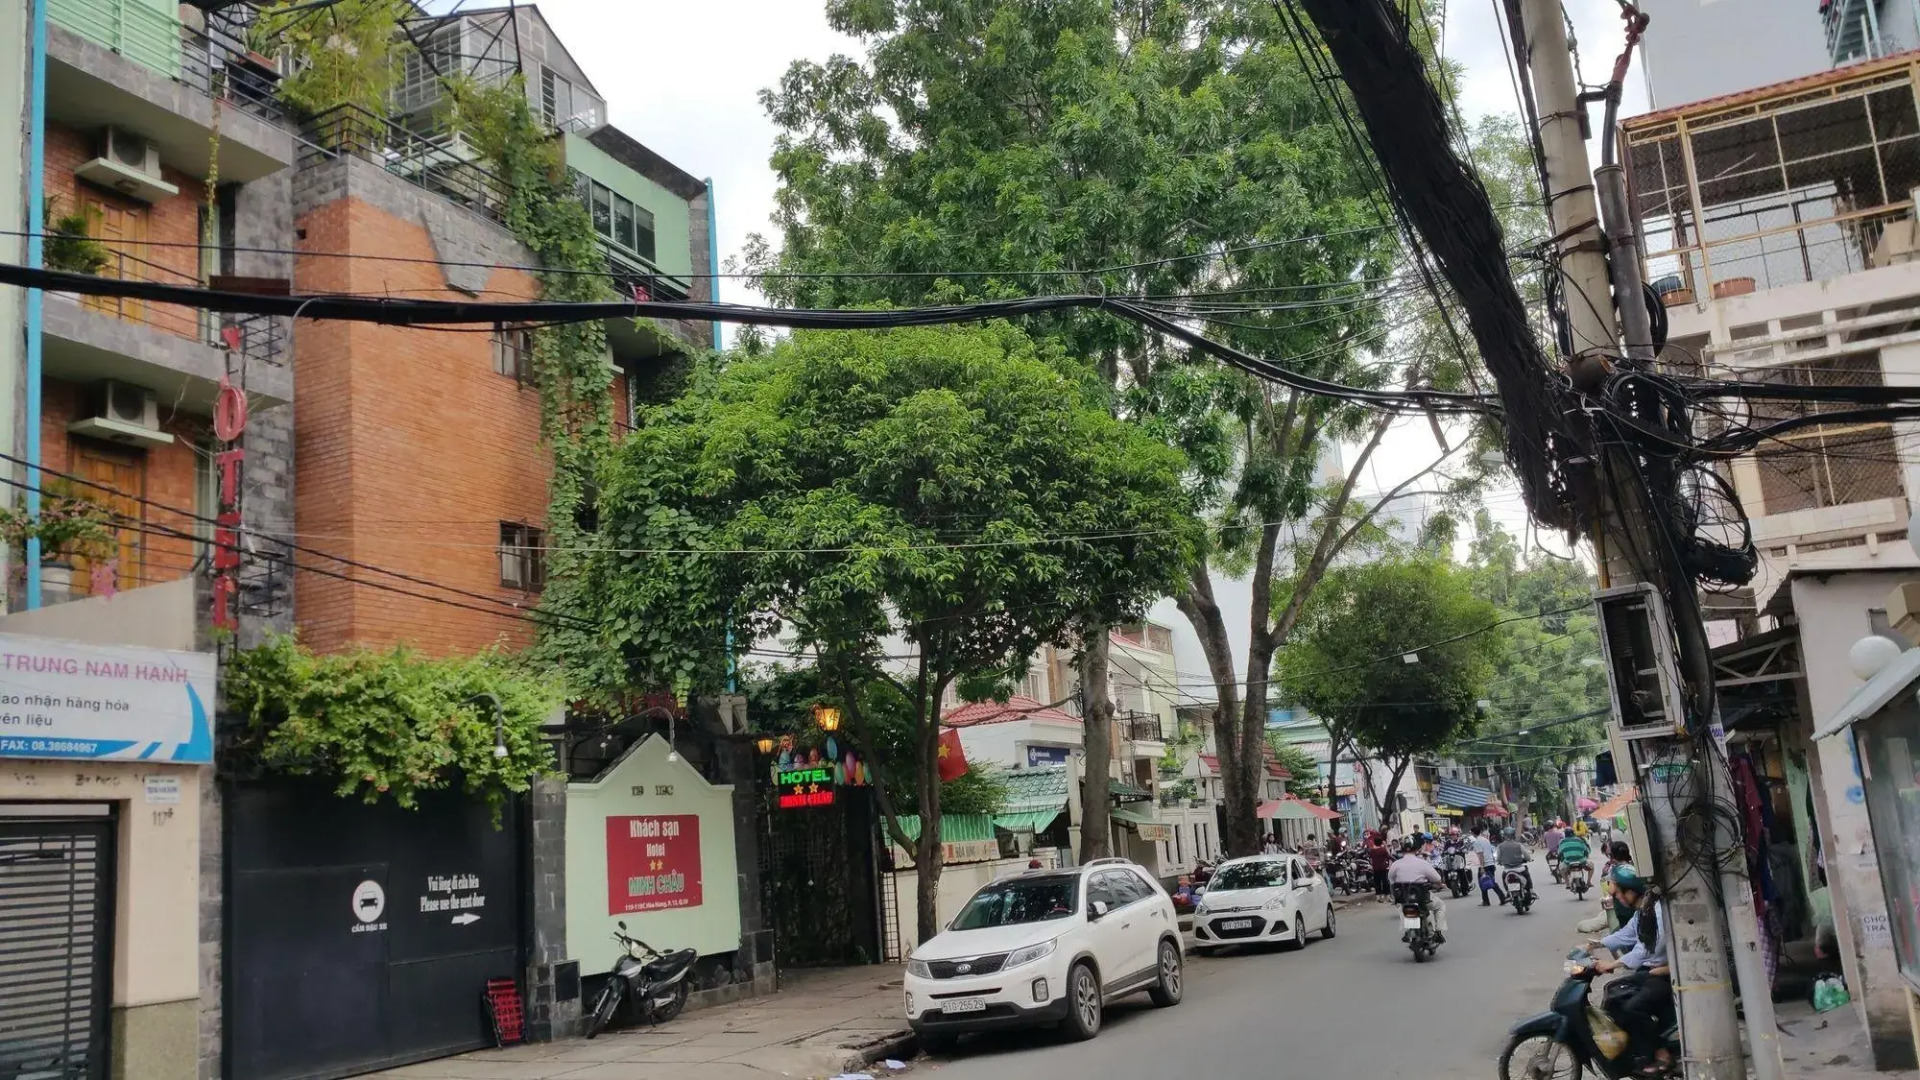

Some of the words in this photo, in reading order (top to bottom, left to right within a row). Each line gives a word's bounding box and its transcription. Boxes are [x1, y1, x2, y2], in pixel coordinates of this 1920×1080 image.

[3, 654, 78, 675] TRUNG
[85, 660, 128, 678] NAM
[25, 695, 61, 709] nhận
[26, 714, 53, 727] liệu
[1, 740, 29, 750] FAX:
[781, 769, 831, 785] HOTEL
[630, 818, 660, 838] Khách
[662, 821, 679, 840] sạn
[646, 843, 665, 857] Hotel
[427, 876, 438, 891] Vui
[628, 875, 655, 897] MINH
[656, 869, 684, 894] CHÂU
[420, 896, 439, 912] Please
[450, 894, 460, 909] the
[460, 894, 472, 908] next
[472, 892, 485, 907] door
